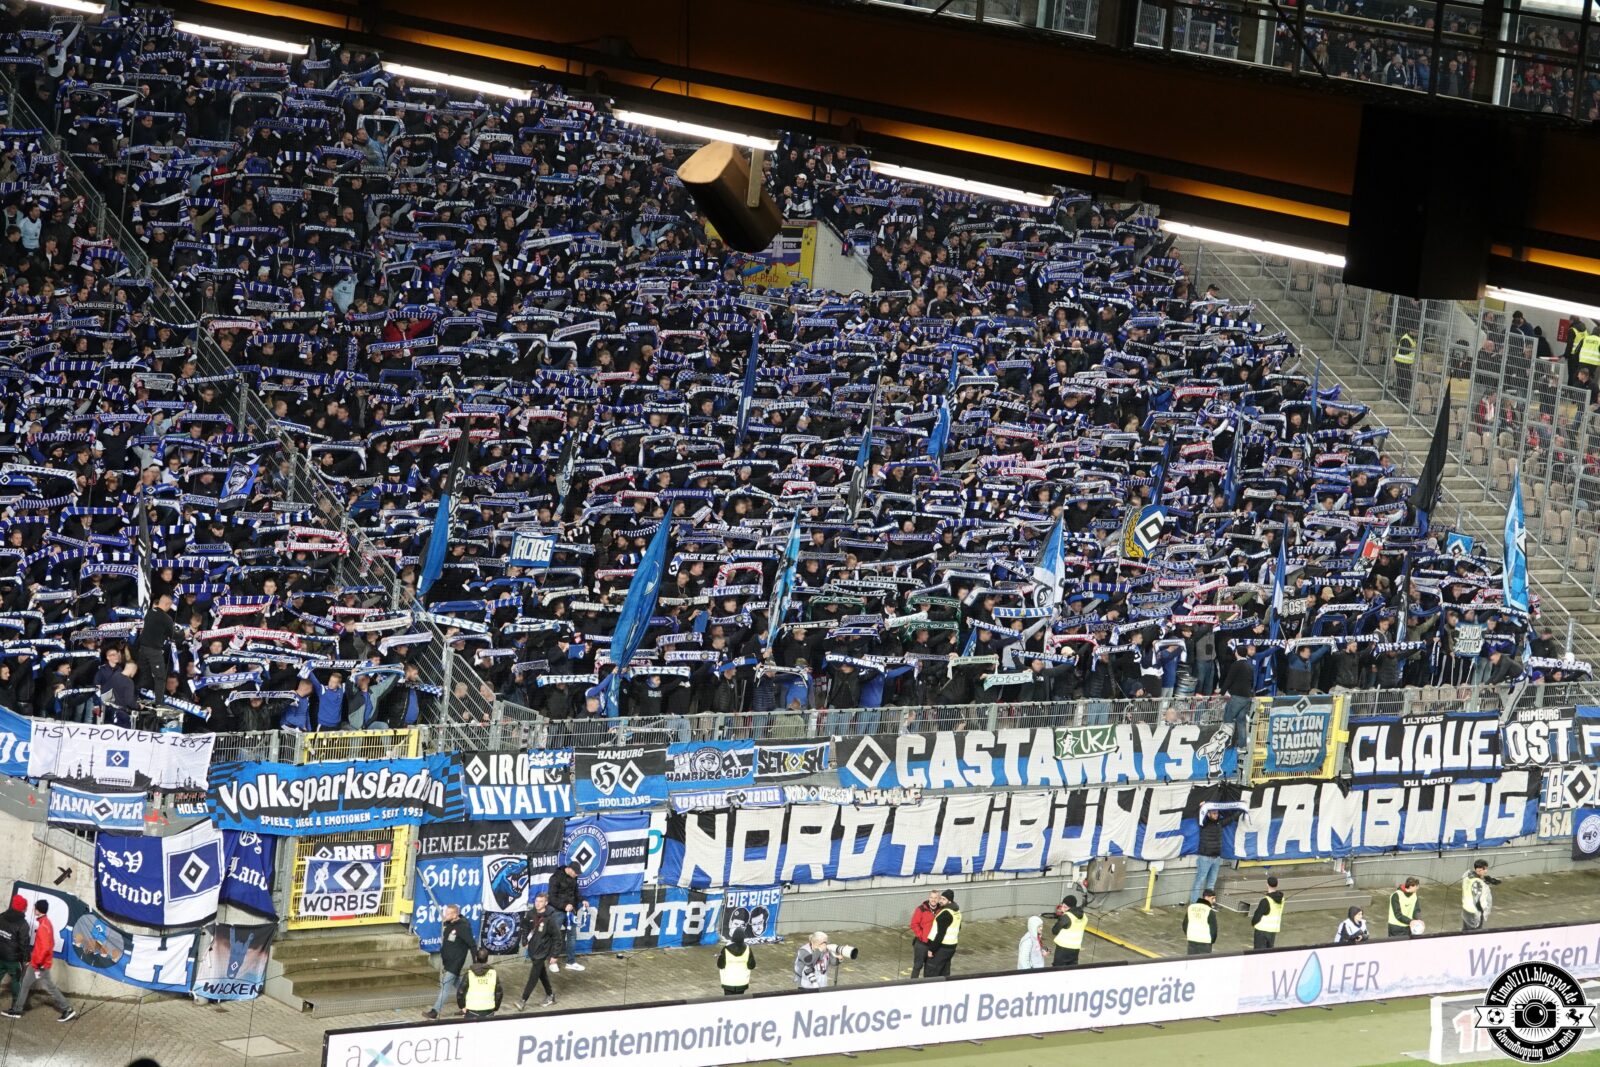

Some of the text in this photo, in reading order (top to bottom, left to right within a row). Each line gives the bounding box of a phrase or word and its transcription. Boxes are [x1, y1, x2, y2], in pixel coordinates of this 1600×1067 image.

[87, 565, 138, 574] HAMBURG
[974, 619, 1019, 637] CASTAWAYS
[1018, 650, 1068, 663] CASTAWAYS
[1273, 715, 1324, 732] SEKTION
[1402, 715, 1443, 724] ULTRAS
[1518, 709, 1560, 721] HAMBURG
[34, 725, 164, 744] HSV-POWER
[1272, 732, 1322, 750] STADION
[1506, 720, 1573, 764] OST
[597, 748, 645, 760] HAMBURG
[1275, 749, 1320, 765] VERBOT
[666, 771, 722, 782] HAMBURG
[1421, 776, 1453, 786] NORD
[218, 766, 443, 814] Volksparkstadn
[468, 785, 571, 815] LOYALTY
[598, 795, 651, 807] HOOLIGANS
[260, 815, 292, 828] SPIELE,
[324, 812, 371, 826] EMOTIONEN
[382, 808, 399, 820] SEIT
[403, 806, 424, 817] 1953
[1234, 770, 1528, 857] HAMBURG
[1538, 811, 1573, 838] BSA
[610, 846, 645, 859] ROTHOSEN
[423, 864, 480, 890] Hafen
[303, 893, 378, 912] WORBIS
[727, 889, 781, 908] BIERIGE
[577, 899, 722, 940] OJEKT87
[1469, 945, 1513, 977] Wir
[202, 981, 264, 996] WACKEN
[517, 977, 1195, 1064] Patientenmonitore, Narkose- und Beatmungsgeräte
